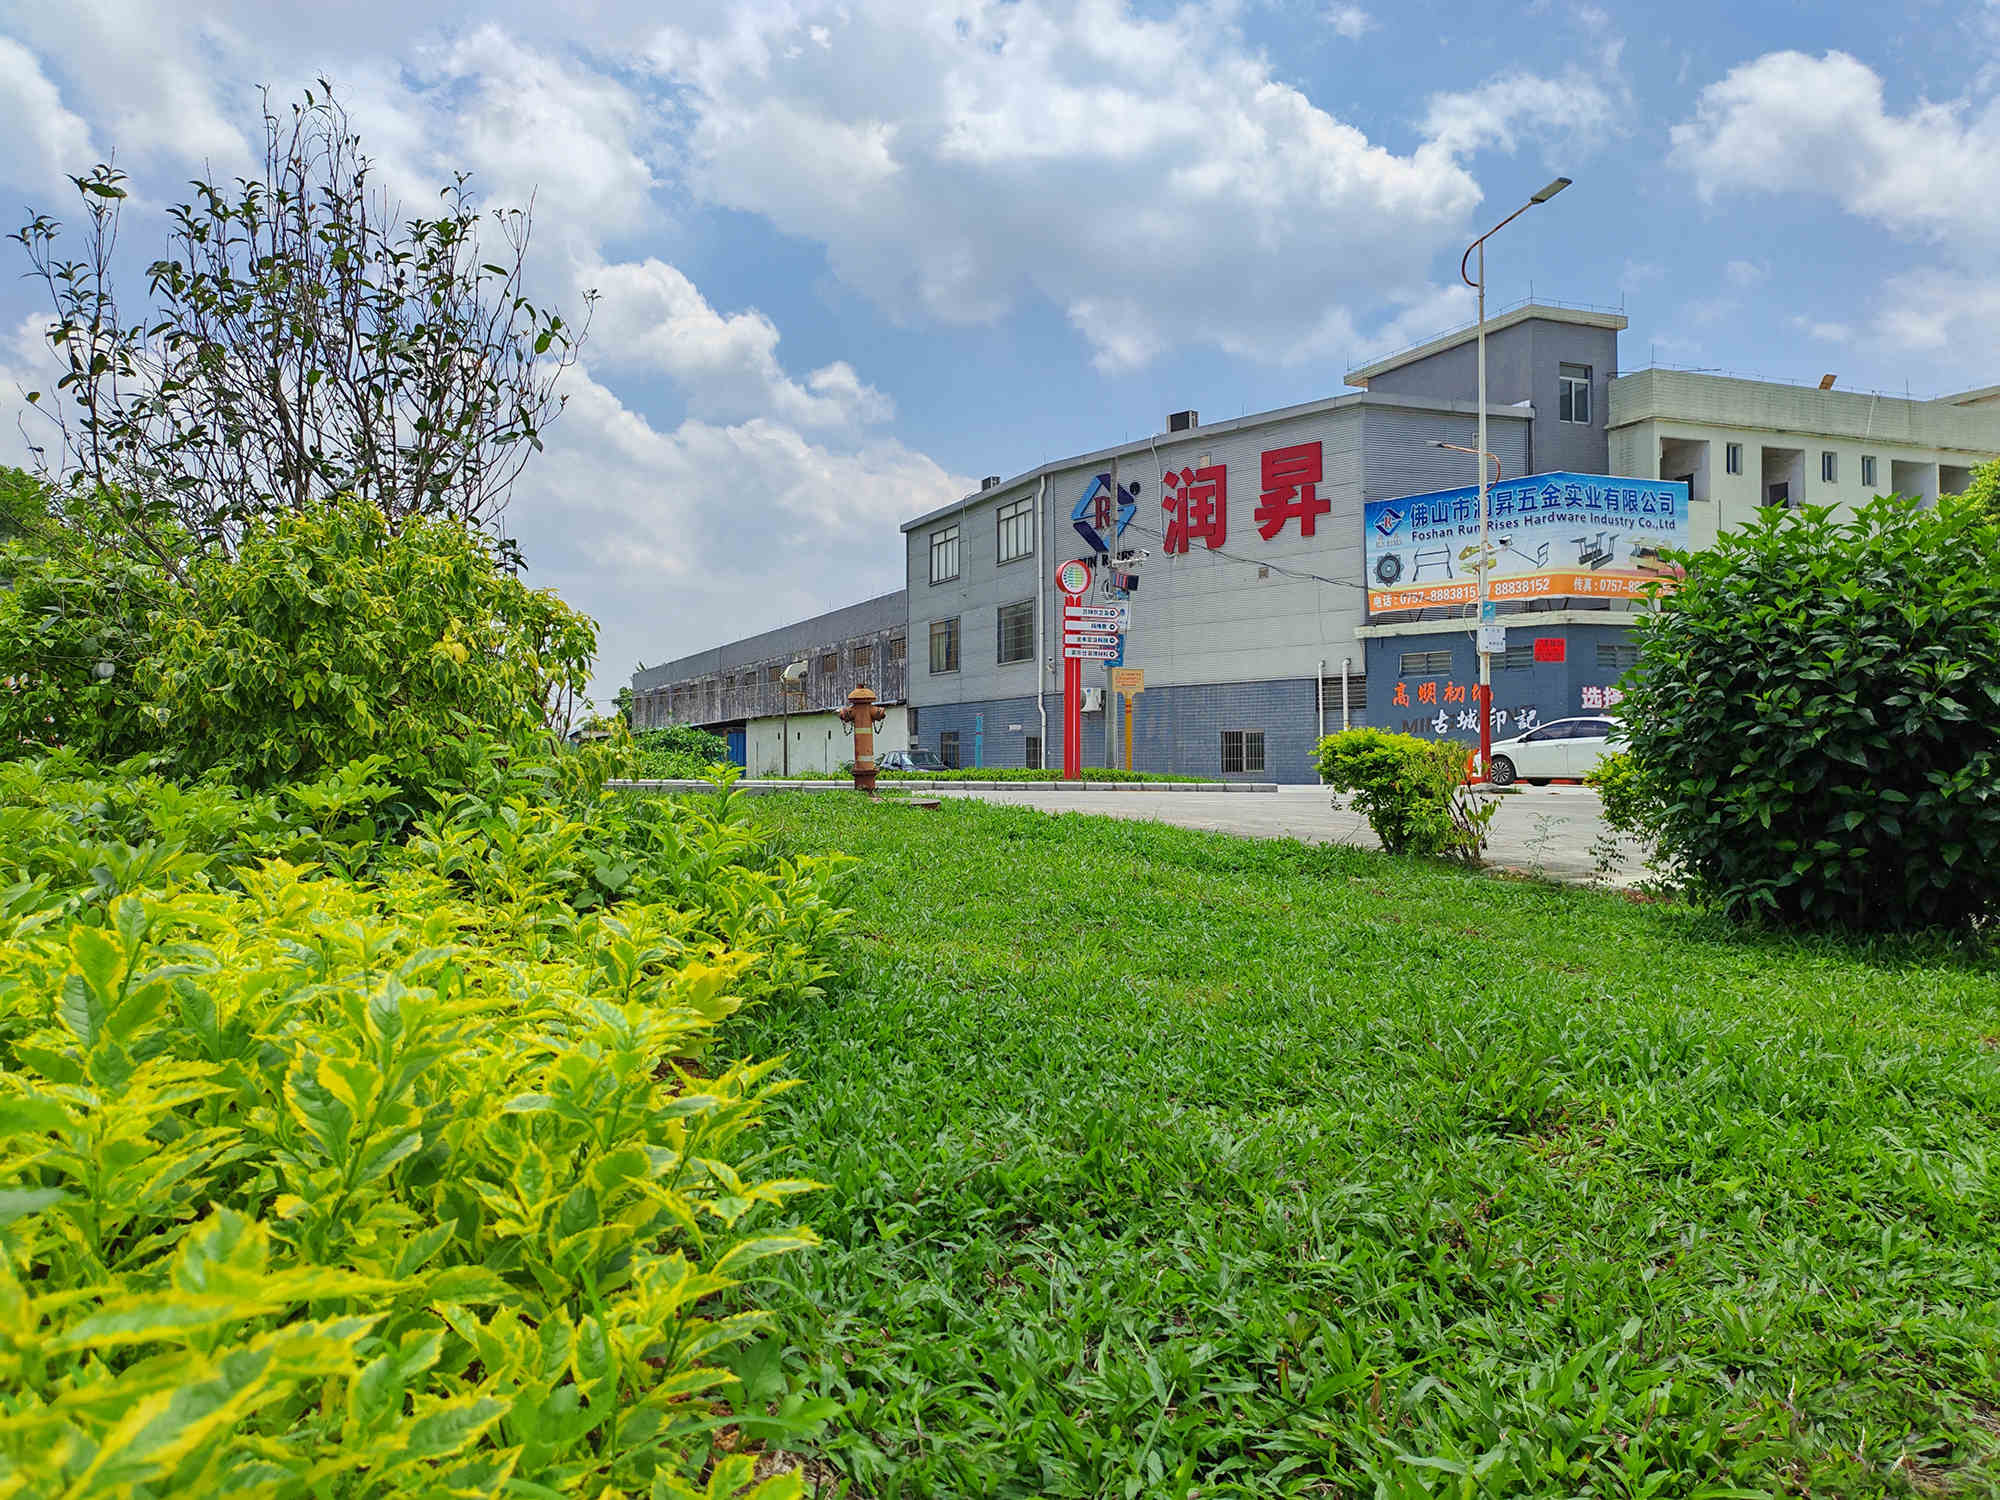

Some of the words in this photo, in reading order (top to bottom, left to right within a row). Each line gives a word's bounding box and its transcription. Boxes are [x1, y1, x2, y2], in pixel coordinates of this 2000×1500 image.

[1162, 441, 1331, 554] 润昇
[1412, 528, 1453, 542] Foshan
[1458, 524, 1480, 537] Run
[1487, 517, 1519, 531] Rises
[1524, 512, 1586, 527] Hardware
[1590, 513, 1634, 530] Industry
[1639, 517, 1676, 530] Co.,Ltd
[1495, 579, 1550, 595] 88838152
